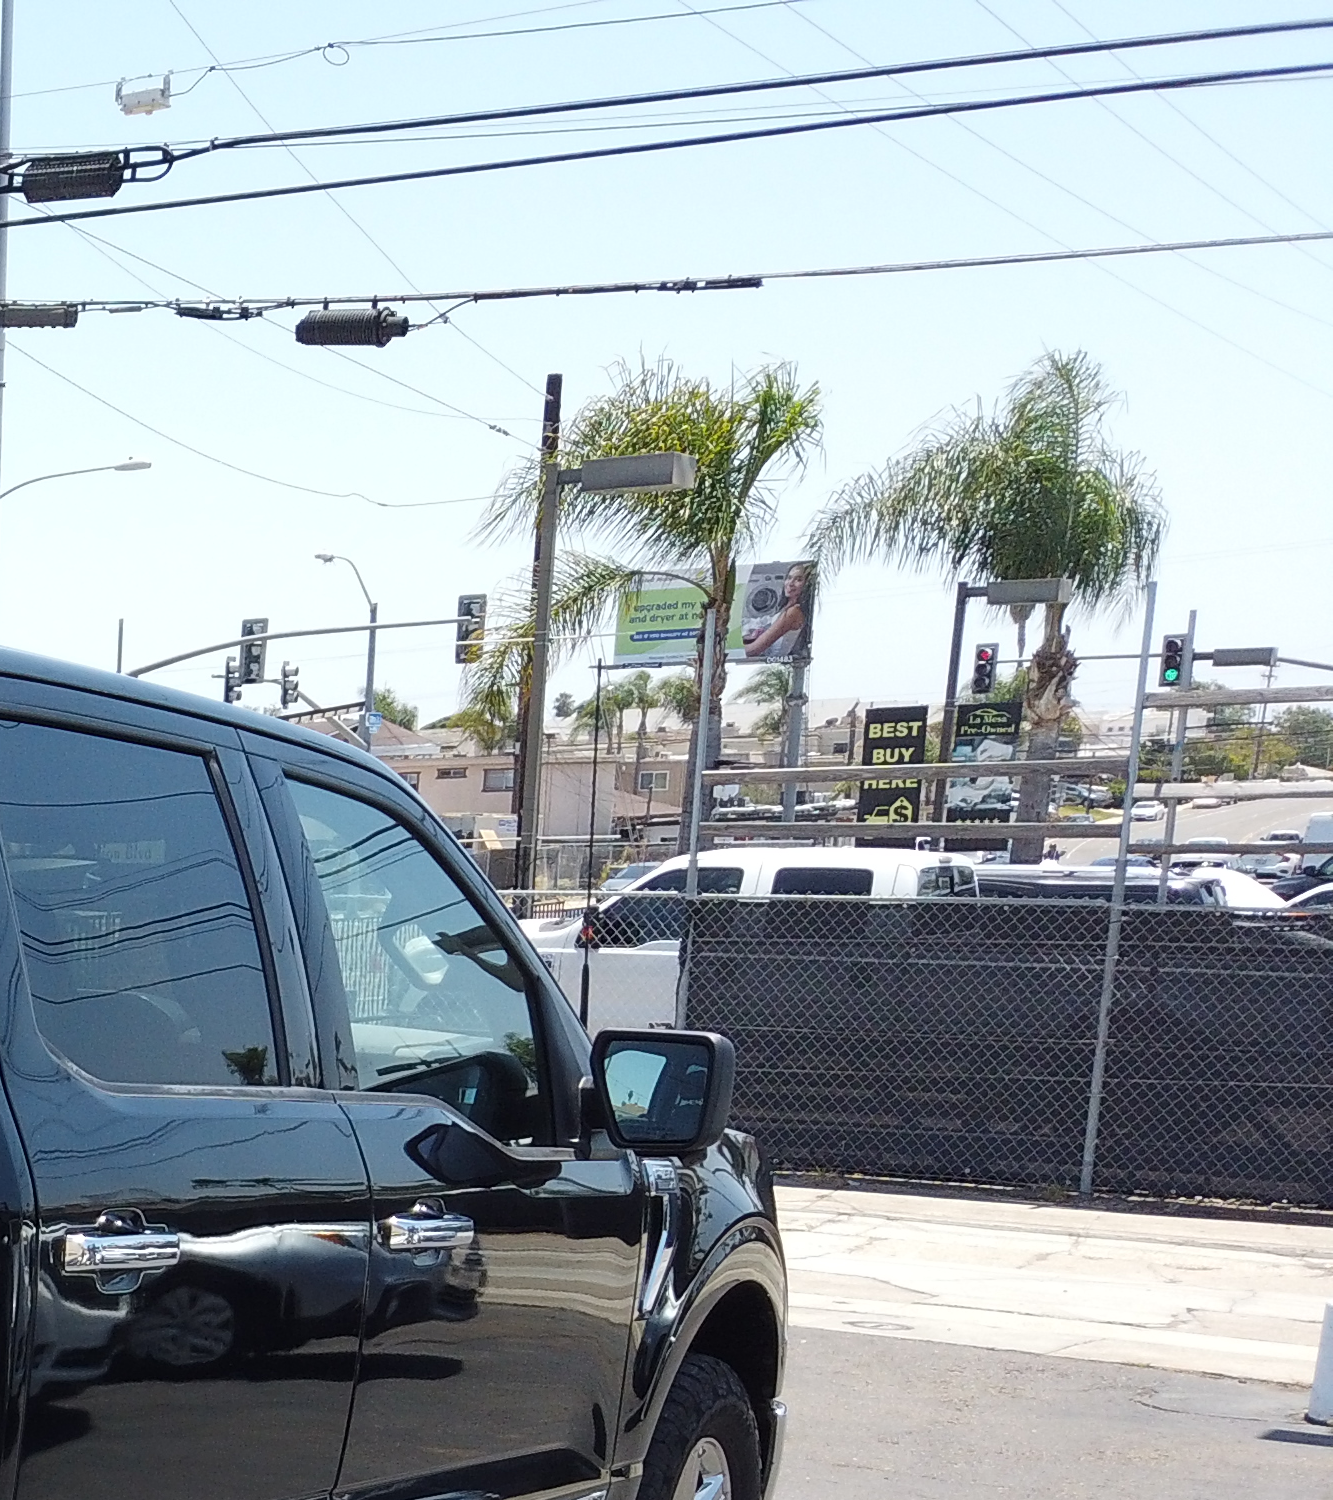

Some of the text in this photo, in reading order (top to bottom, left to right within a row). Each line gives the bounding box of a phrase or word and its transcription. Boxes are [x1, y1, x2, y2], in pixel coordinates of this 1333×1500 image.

[968, 714, 1008, 724] La Mesa
[868, 721, 923, 739] BEST
[960, 724, 1015, 735] Pre-Owned
[872, 747, 915, 764] BUY
